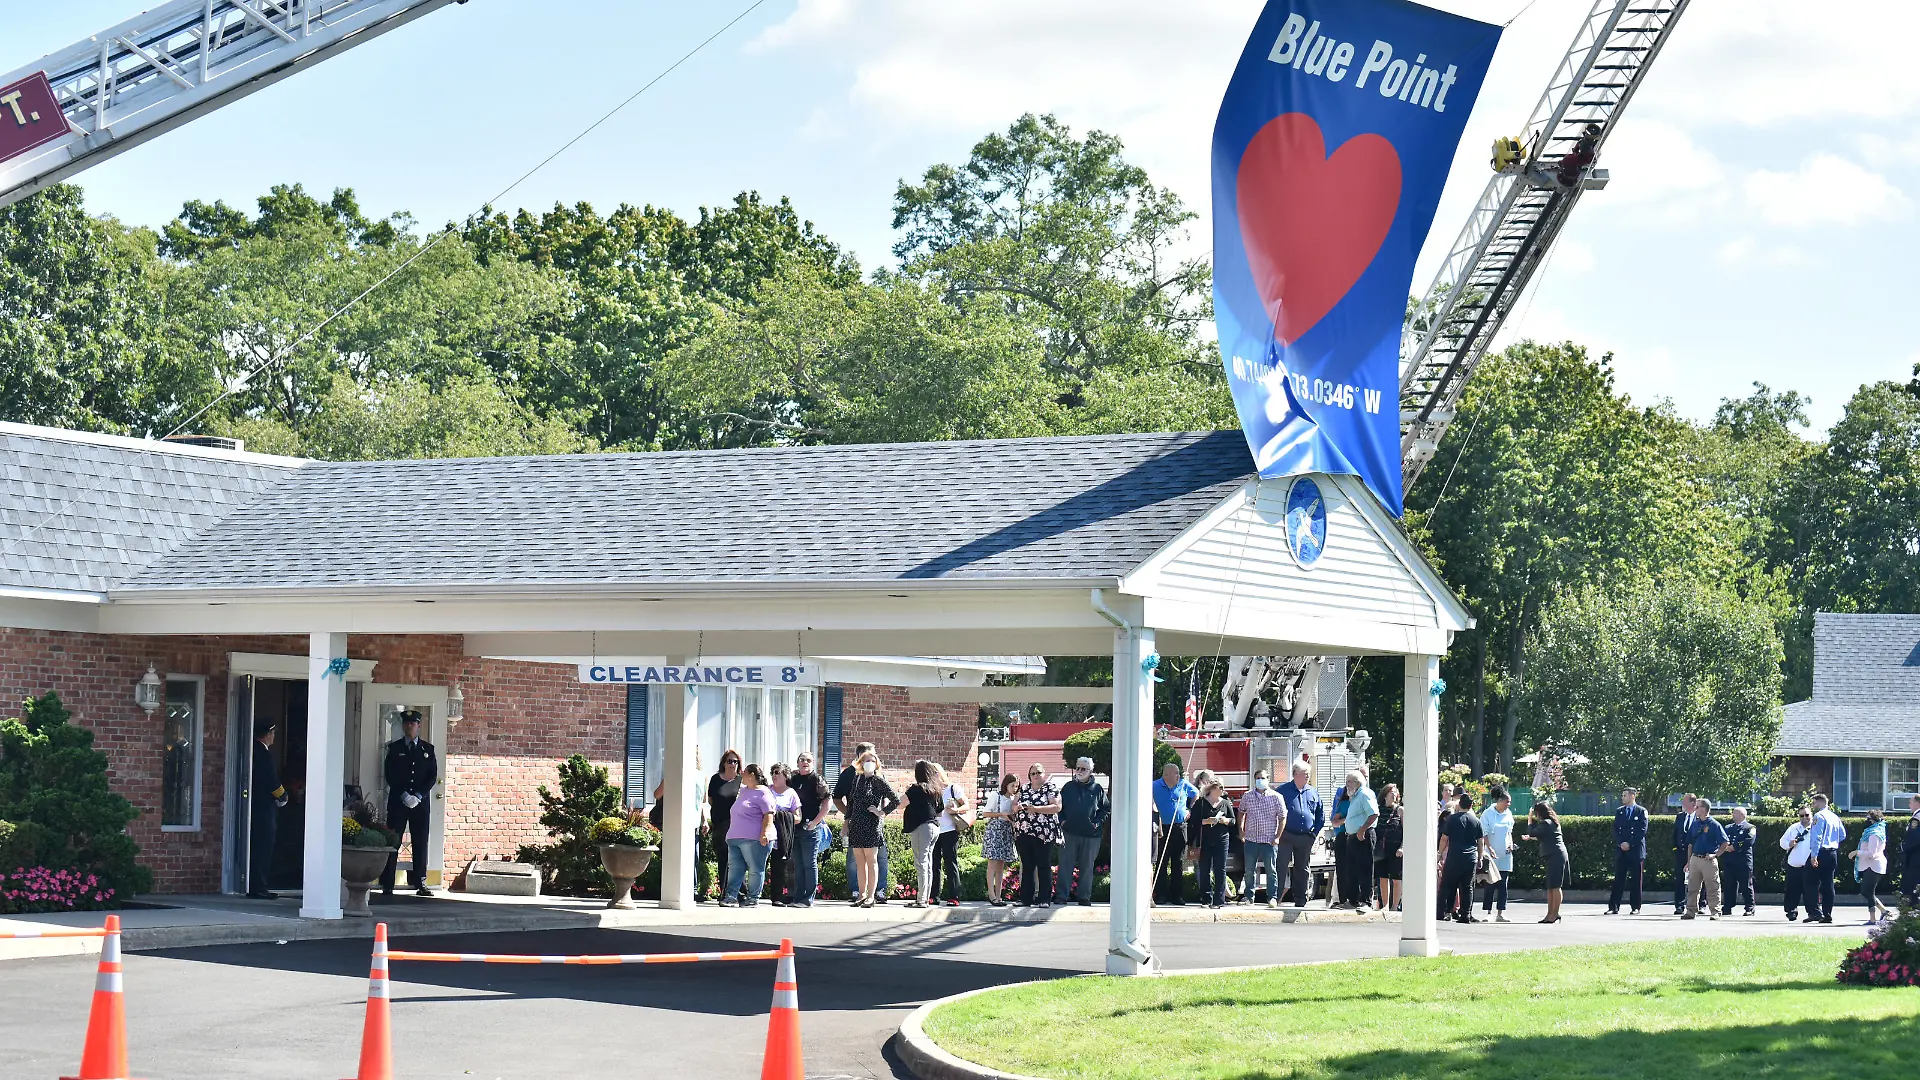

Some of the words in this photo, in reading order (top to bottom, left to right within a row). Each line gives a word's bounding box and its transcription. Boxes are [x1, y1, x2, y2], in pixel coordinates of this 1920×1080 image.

[1267, 12, 1355, 82] Blue
[1355, 39, 1458, 112] Point
[0, 90, 40, 125] T.
[1363, 388, 1381, 414] W
[588, 666, 763, 682] CLEARANCE
[781, 666, 804, 682] 8'
